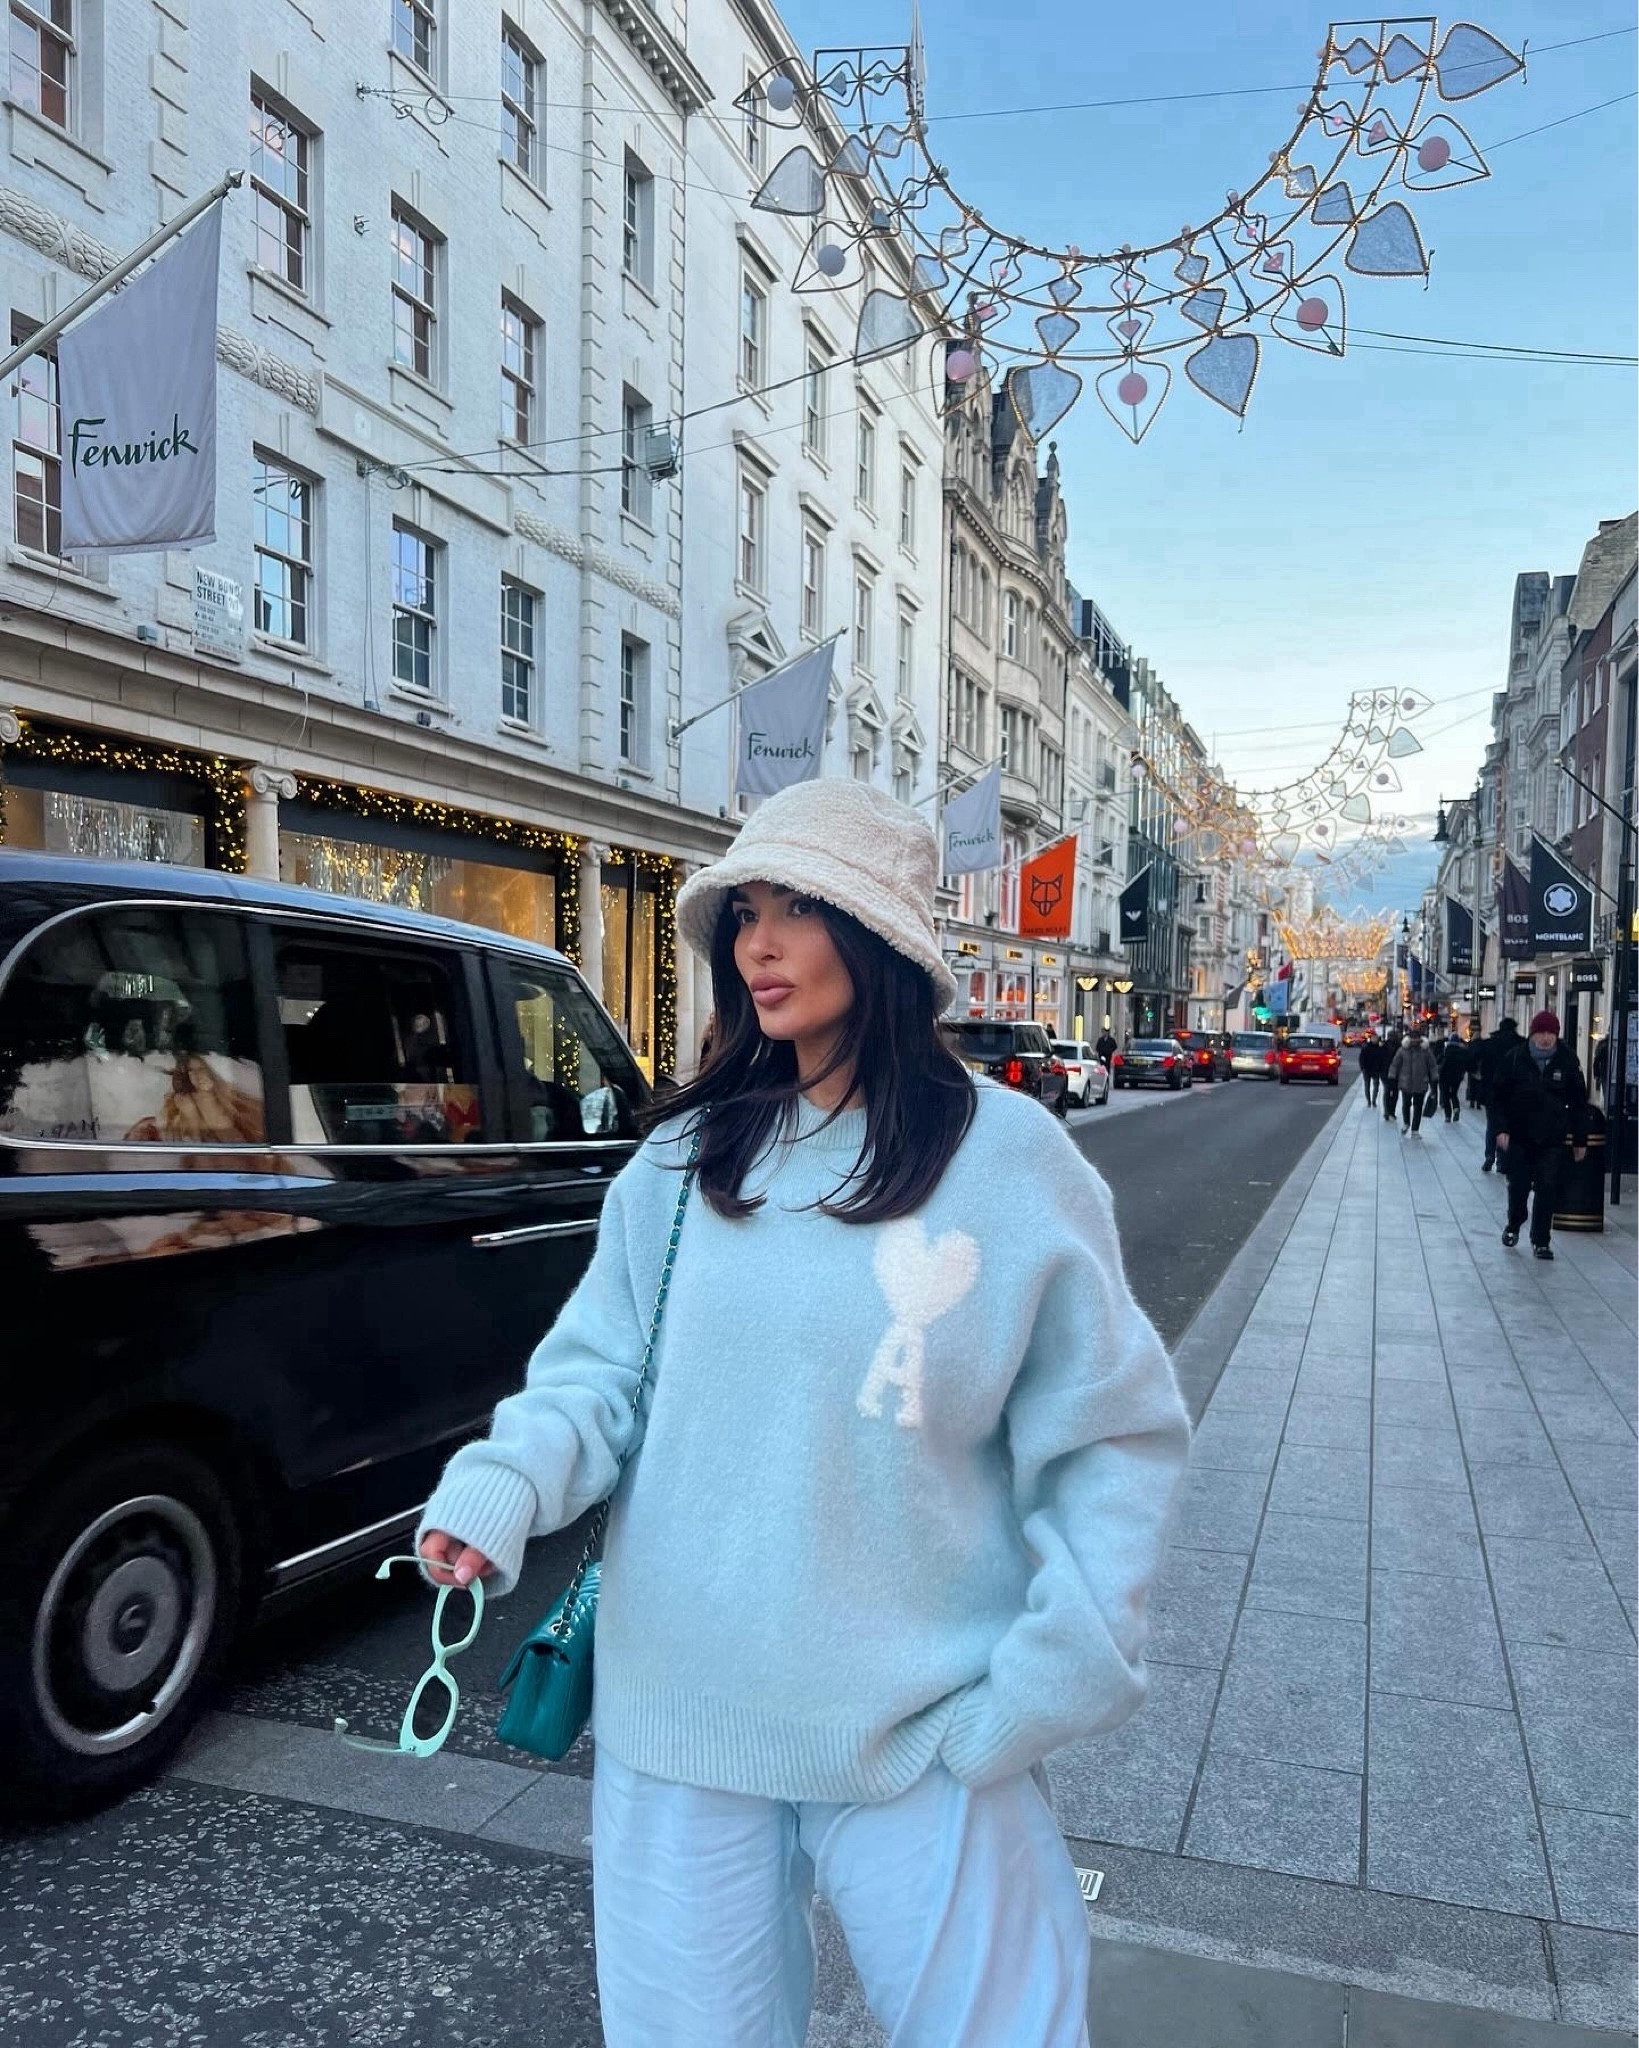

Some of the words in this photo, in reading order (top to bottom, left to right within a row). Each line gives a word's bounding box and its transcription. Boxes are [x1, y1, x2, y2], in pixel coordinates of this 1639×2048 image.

[67, 413, 199, 478] Fenwick
[197, 571, 216, 588] NEW
[218, 579, 241, 598] BOND
[197, 585, 225, 607] STREET
[747, 732, 816, 761] Fenwick
[948, 828, 995, 852] Fenwick
[1507, 914, 1529, 924] BOS
[1535, 932, 1585, 941] MONTBLANC
[1576, 974, 1598, 983] BOSS
